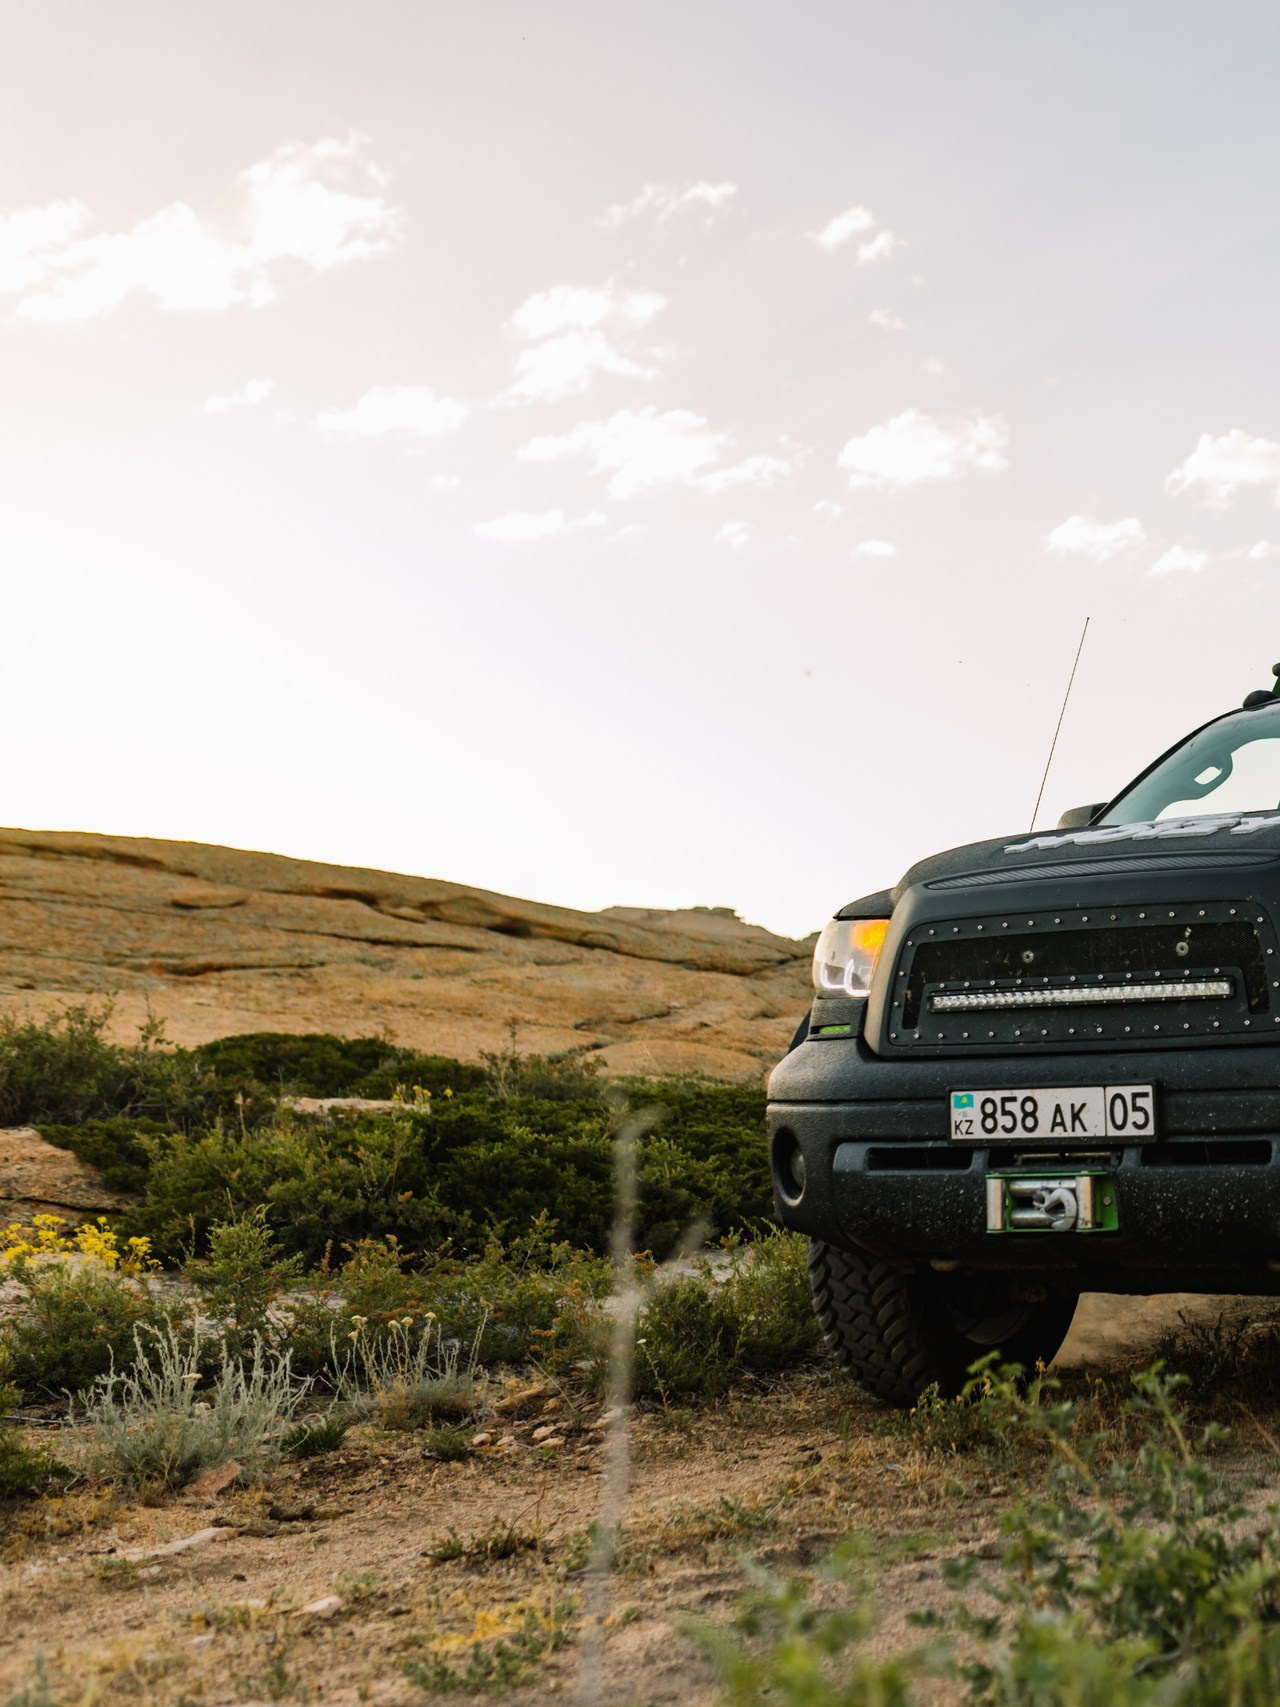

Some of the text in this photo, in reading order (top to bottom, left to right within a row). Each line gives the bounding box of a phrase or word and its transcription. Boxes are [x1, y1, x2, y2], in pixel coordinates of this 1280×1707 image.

[953, 1119, 974, 1135] KZ
[980, 1092, 1150, 1134] 858 AK 05
